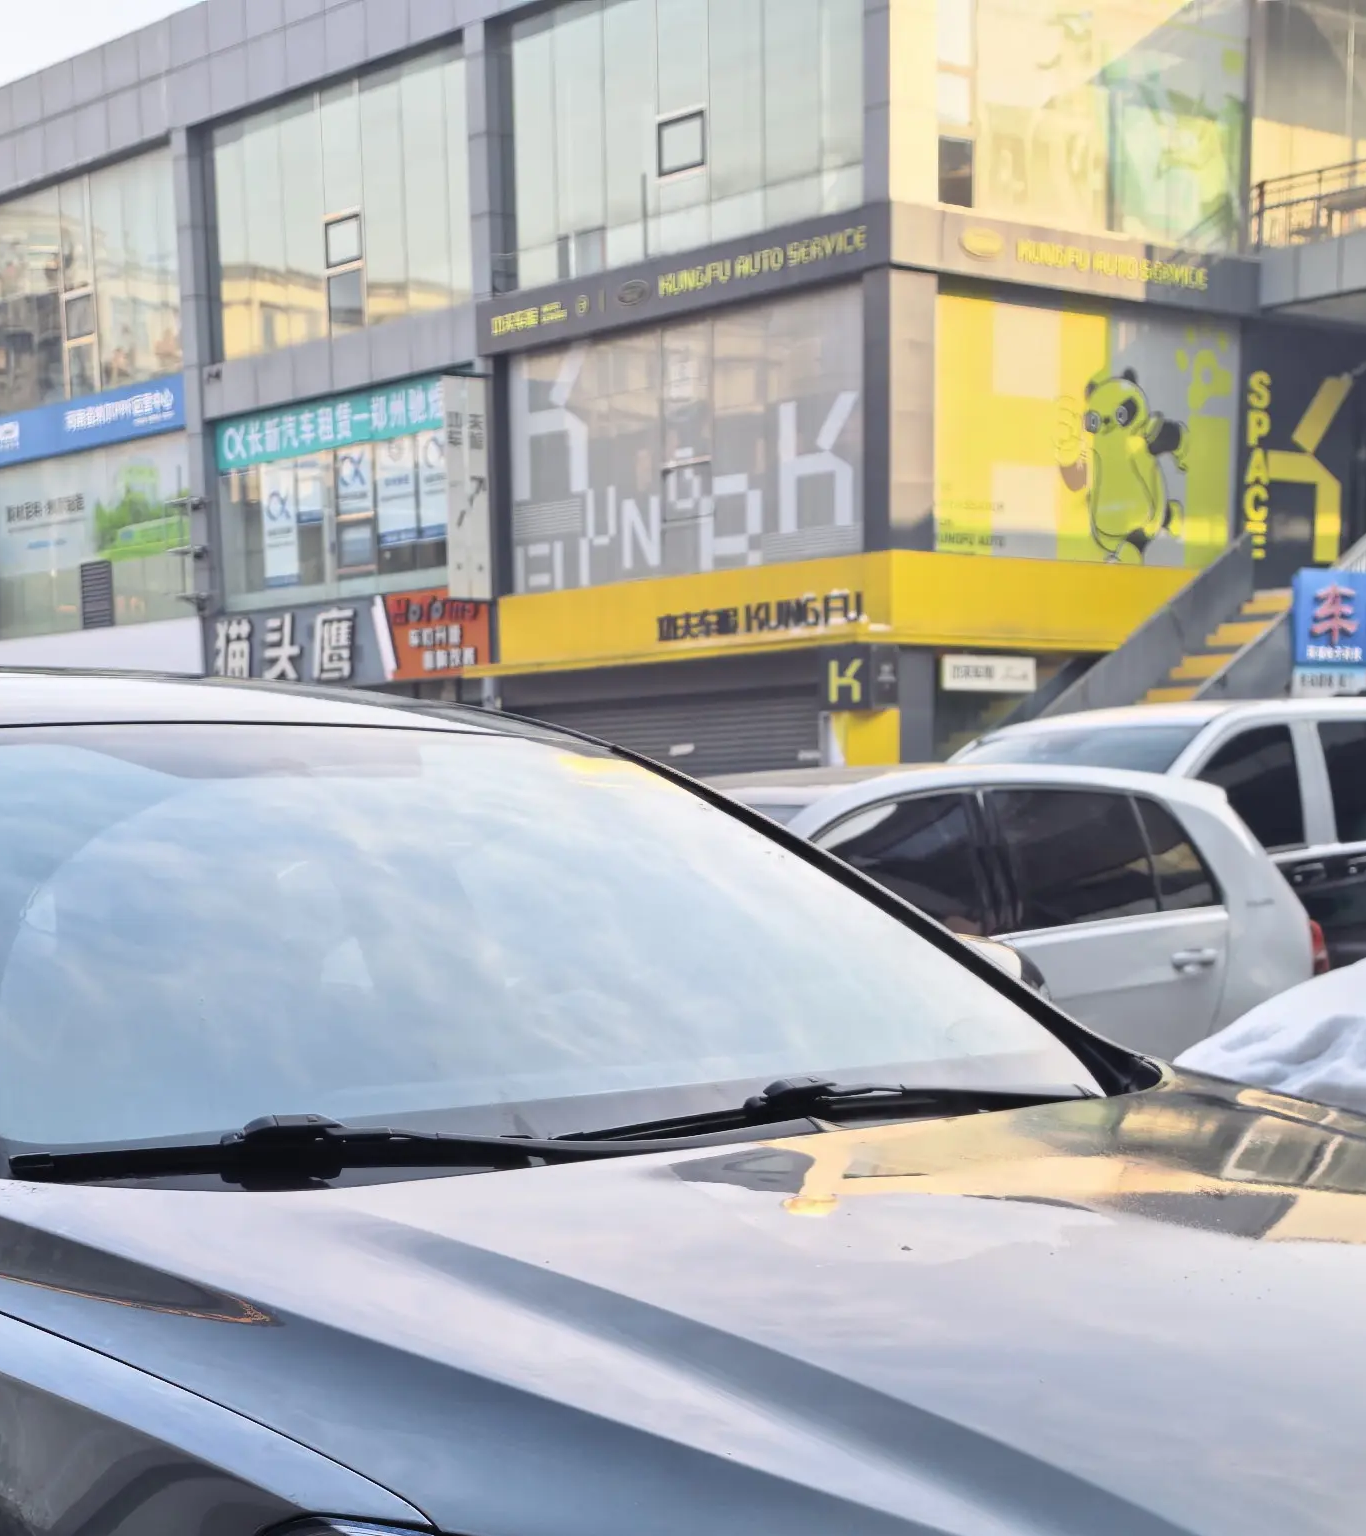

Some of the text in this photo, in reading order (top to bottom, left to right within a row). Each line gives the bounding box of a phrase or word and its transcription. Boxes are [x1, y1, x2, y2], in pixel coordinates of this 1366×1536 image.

[657, 225, 868, 299] KUNGFU AUTO SERVICE
[1243, 370, 1272, 560] SPACE
[214, 605, 355, 683] 猫头鹰
[656, 606, 739, 643] 功夫车服
[827, 658, 864, 704] K
